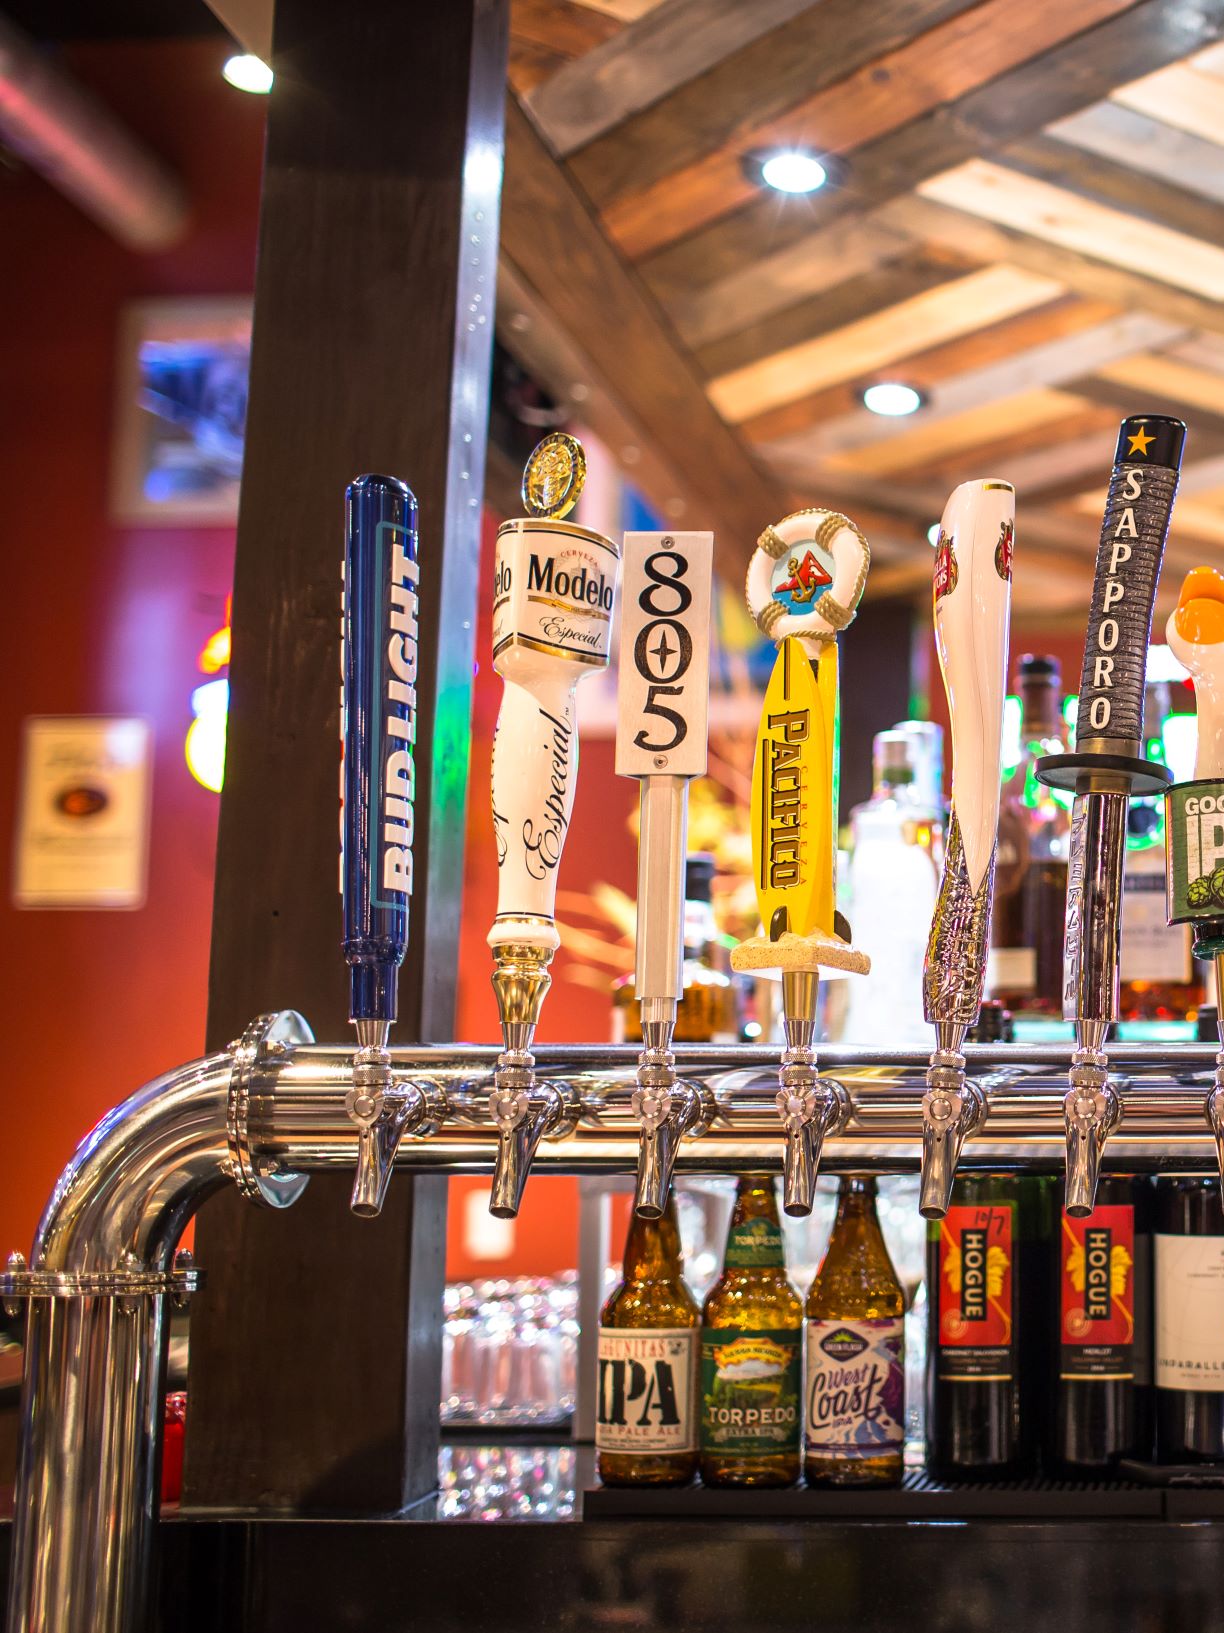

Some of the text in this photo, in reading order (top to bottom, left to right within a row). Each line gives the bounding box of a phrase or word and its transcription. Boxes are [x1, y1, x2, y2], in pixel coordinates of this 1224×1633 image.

[527, 554, 613, 611] Modelo
[560, 550, 598, 568] CERVEZA
[1089, 469, 1144, 729] SAPPORO
[387, 544, 420, 745] LIGHT
[539, 616, 602, 648] Especial
[633, 551, 693, 752] 805
[382, 749, 417, 897] BUD
[523, 708, 574, 881] Especial
[767, 708, 810, 890] PACIFICO
[800, 765, 808, 885] CERVEZA
[964, 1233, 983, 1317] HOGUE
[1088, 1233, 1107, 1316] HOGUE
[598, 1359, 681, 1426] IPA
[708, 1406, 797, 1427] TORPEDO
[810, 1364, 882, 1430] Coast
[828, 1363, 870, 1391] West
